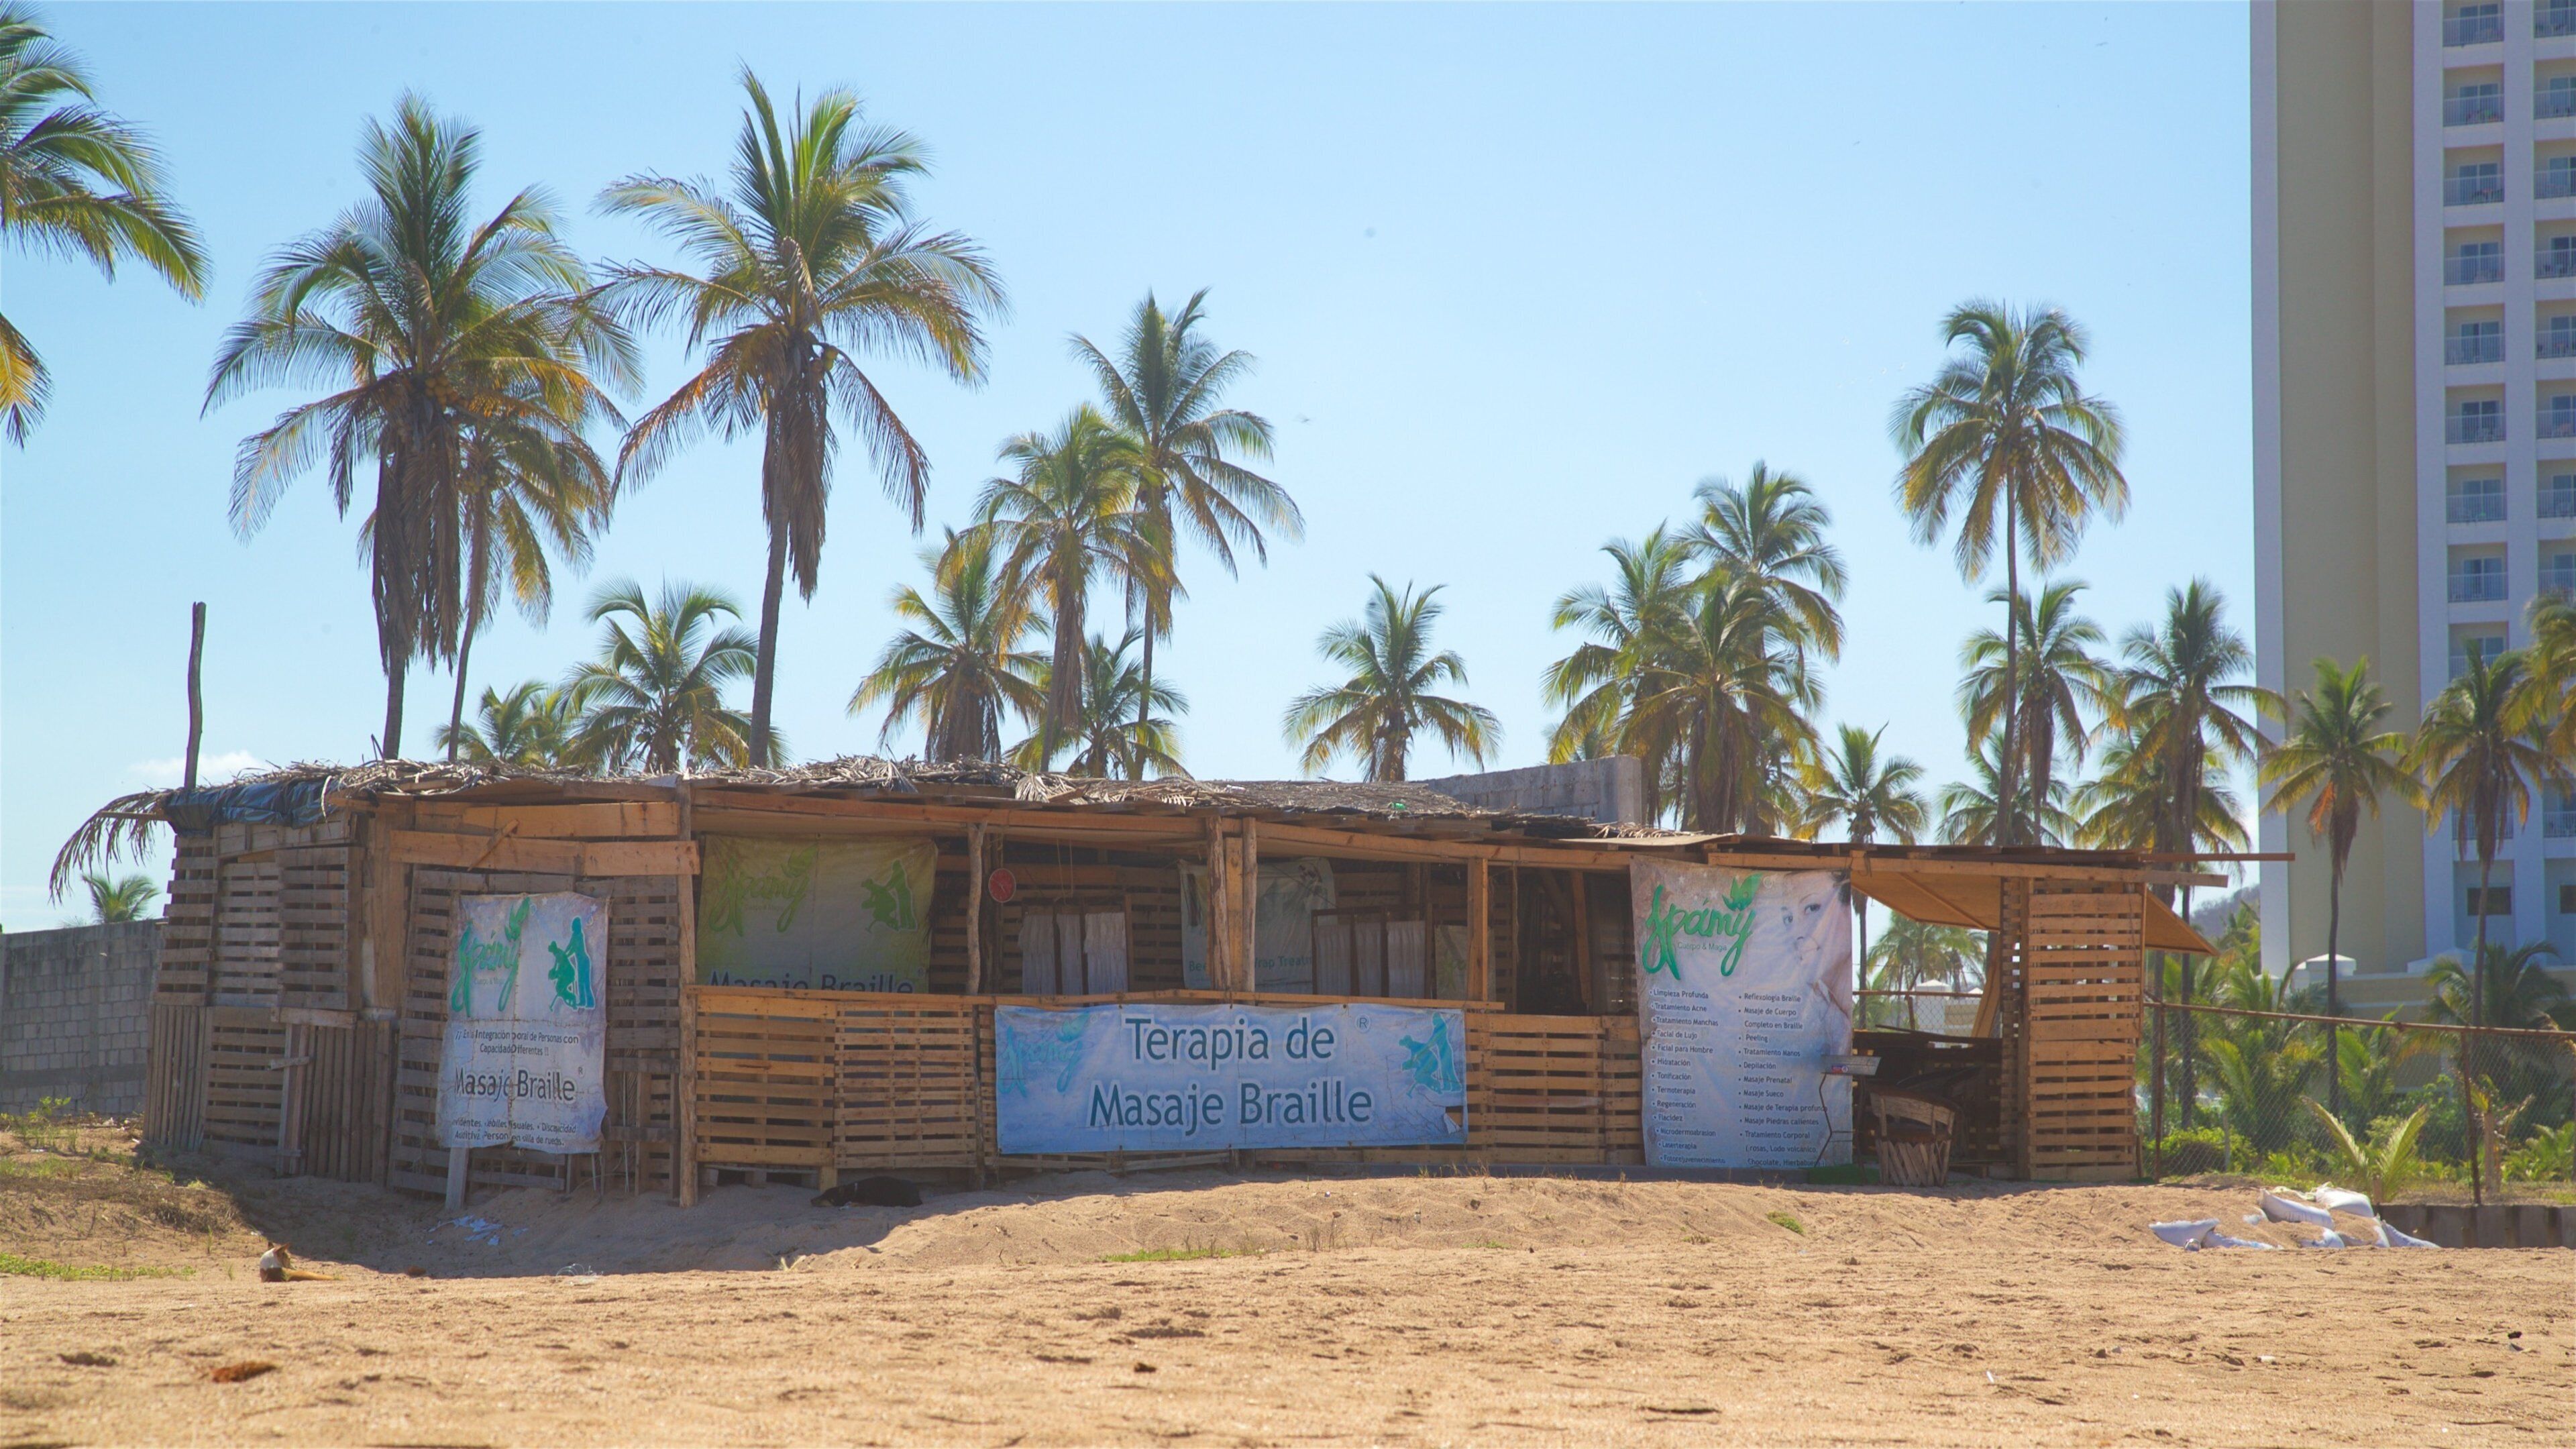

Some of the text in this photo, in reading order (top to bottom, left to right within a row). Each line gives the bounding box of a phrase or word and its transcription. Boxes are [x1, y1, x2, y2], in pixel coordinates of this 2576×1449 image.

[1254, 957, 1275, 970] rap
[1654, 989, 1709, 999] Limpieza Profunda
[1782, 994, 1801, 1002] Braille
[1655, 1003, 1690, 1011] Tratamiento
[1743, 1007, 1764, 1016] Masaje
[1774, 1008, 1796, 1017] Cuerpo
[1657, 1016, 1692, 1025] Tratamiento
[1744, 1020, 1774, 1029] Completo
[1784, 1022, 1803, 1030] Braille
[529, 1032, 537, 1041] de
[537, 1032, 562, 1044] Personas
[563, 1035, 579, 1044] con
[1684, 1031, 1697, 1040] Lujo
[1746, 1034, 1768, 1043] Peeling
[1125, 1017, 1269, 1071] Terapia
[1286, 1016, 1334, 1059] de
[1743, 1048, 1782, 1056] Tratamiento
[1657, 1058, 1691, 1066] Hidratación
[1743, 1061, 1776, 1070] Depilación
[1743, 1076, 1792, 1085] Masaje Prenatal
[517, 1069, 575, 1102] Braille
[1657, 1085, 1696, 1095] Termoterapia
[1743, 1089, 1764, 1098] Masaje
[1089, 1080, 1373, 1136] Masaje Braille
[1743, 1104, 1764, 1112] Masaje
[1775, 1104, 1799, 1112] Terapia
[1744, 1117, 1765, 1126] Masaje
[1744, 1130, 1810, 1140] Tratamiento Corporal
[535, 1136, 543, 1144] de
[1747, 1158, 1782, 1167] Chocolate,
